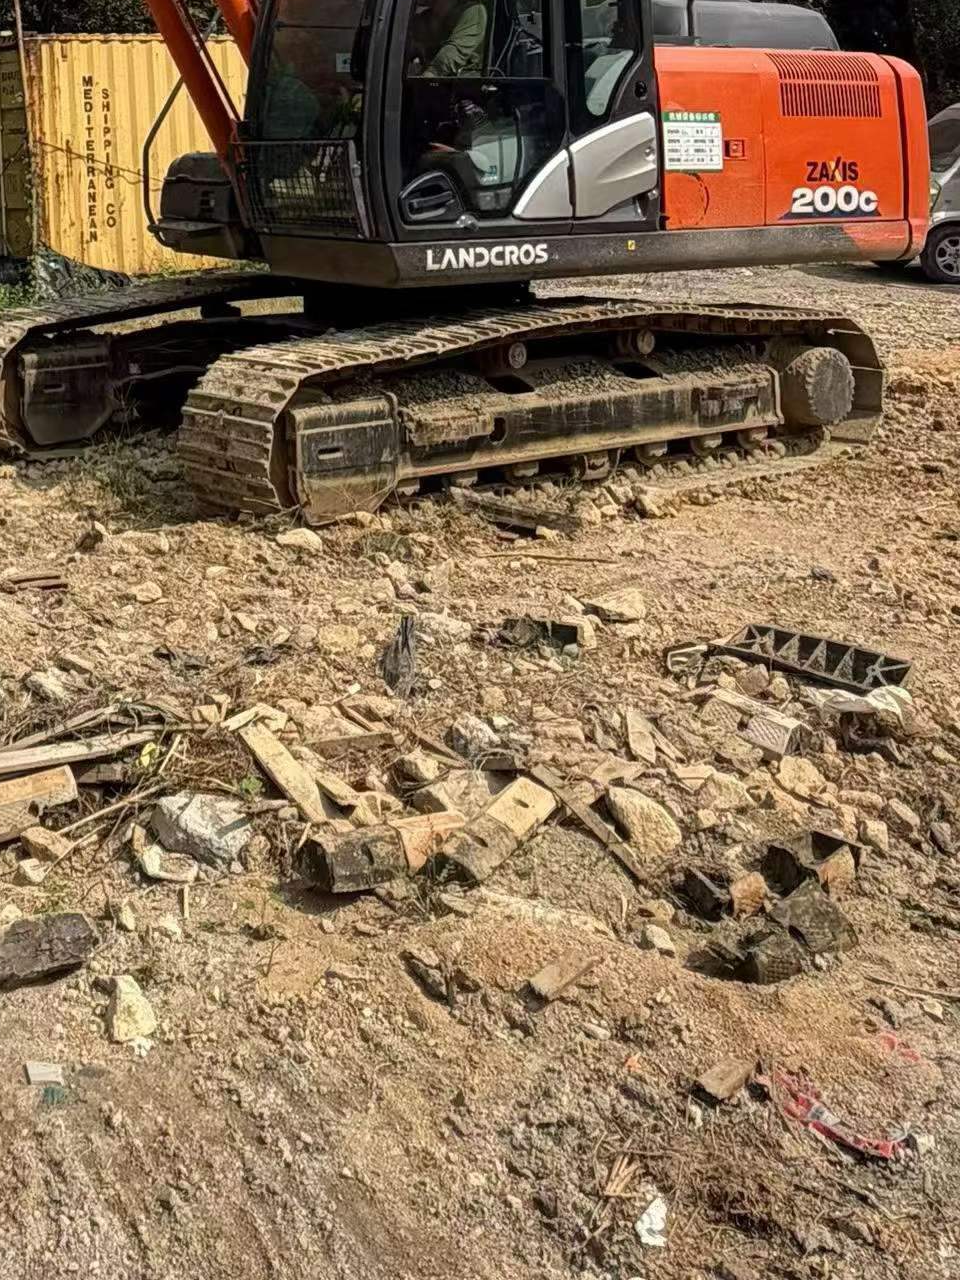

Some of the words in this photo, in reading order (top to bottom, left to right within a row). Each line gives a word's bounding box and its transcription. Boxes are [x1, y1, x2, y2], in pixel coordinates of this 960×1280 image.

[101, 88, 115, 190] SHIPPING
[82, 75, 98, 242] MEDITERRANEAN
[806, 156, 859, 182] ZAXIS
[106, 203, 117, 228] CO
[426, 243, 549, 270] LANDCROS
